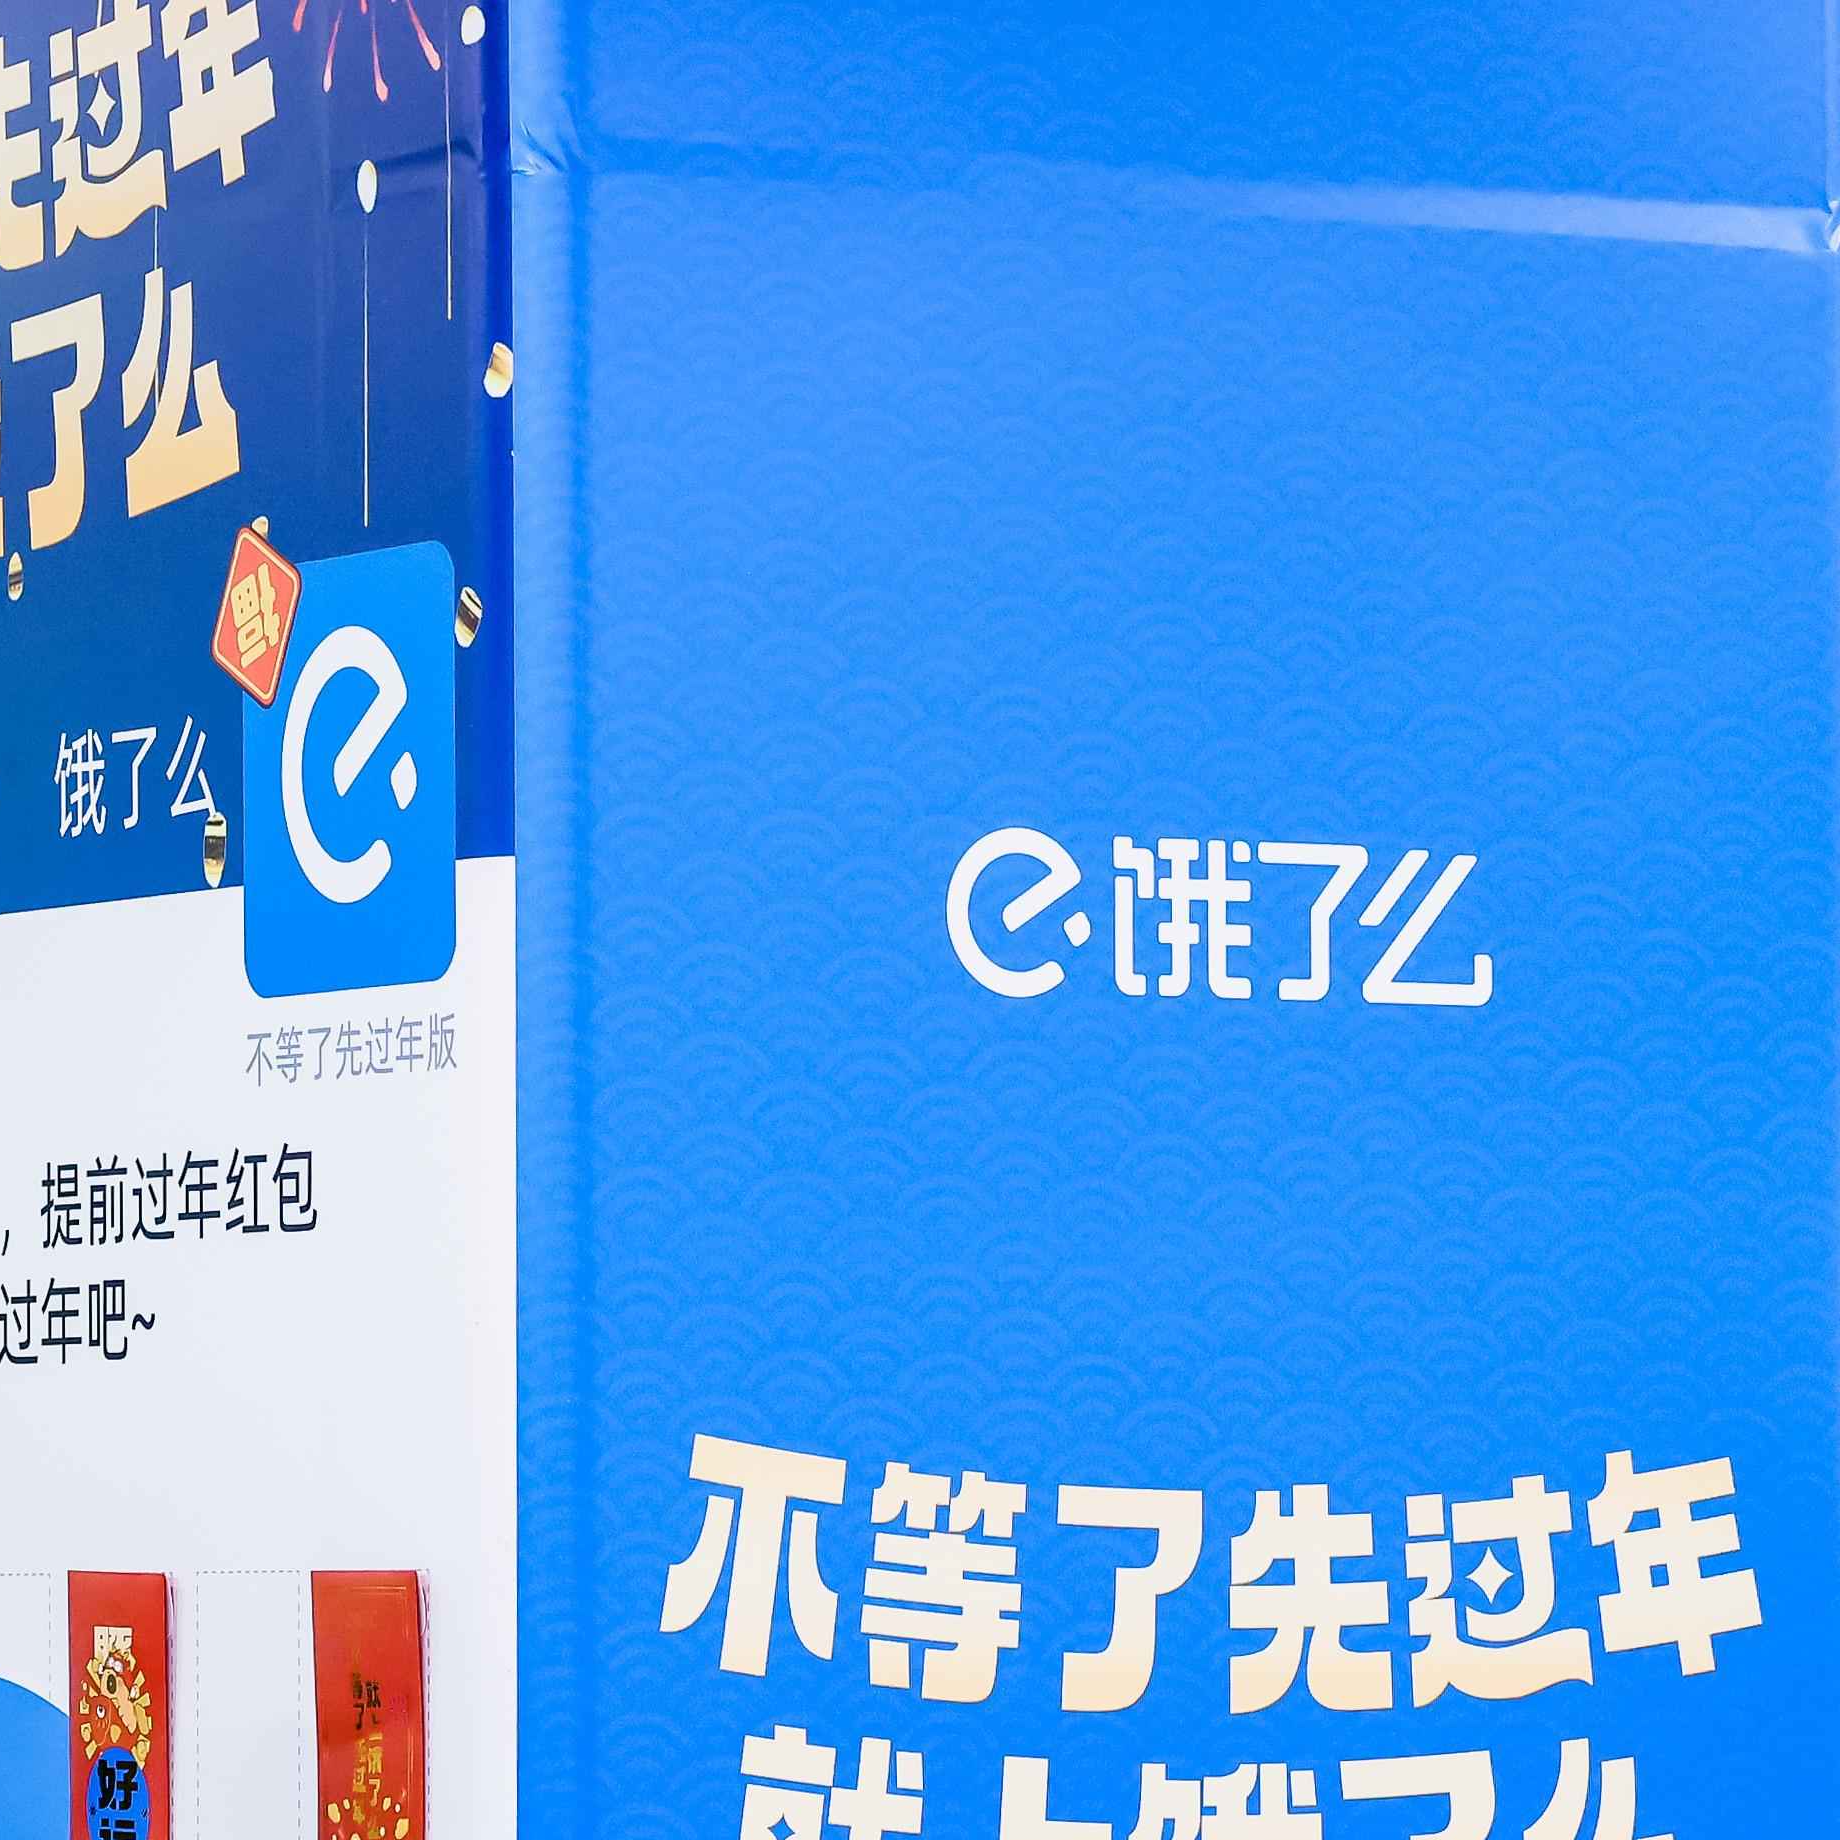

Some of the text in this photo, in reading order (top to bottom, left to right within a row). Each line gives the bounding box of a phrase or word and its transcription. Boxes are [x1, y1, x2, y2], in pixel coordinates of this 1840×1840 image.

[54, 716, 220, 838] 饿了么
[245, 1012, 458, 1088] 不等了先过年版
[659, 1432, 1764, 1717] 不等了先过年
